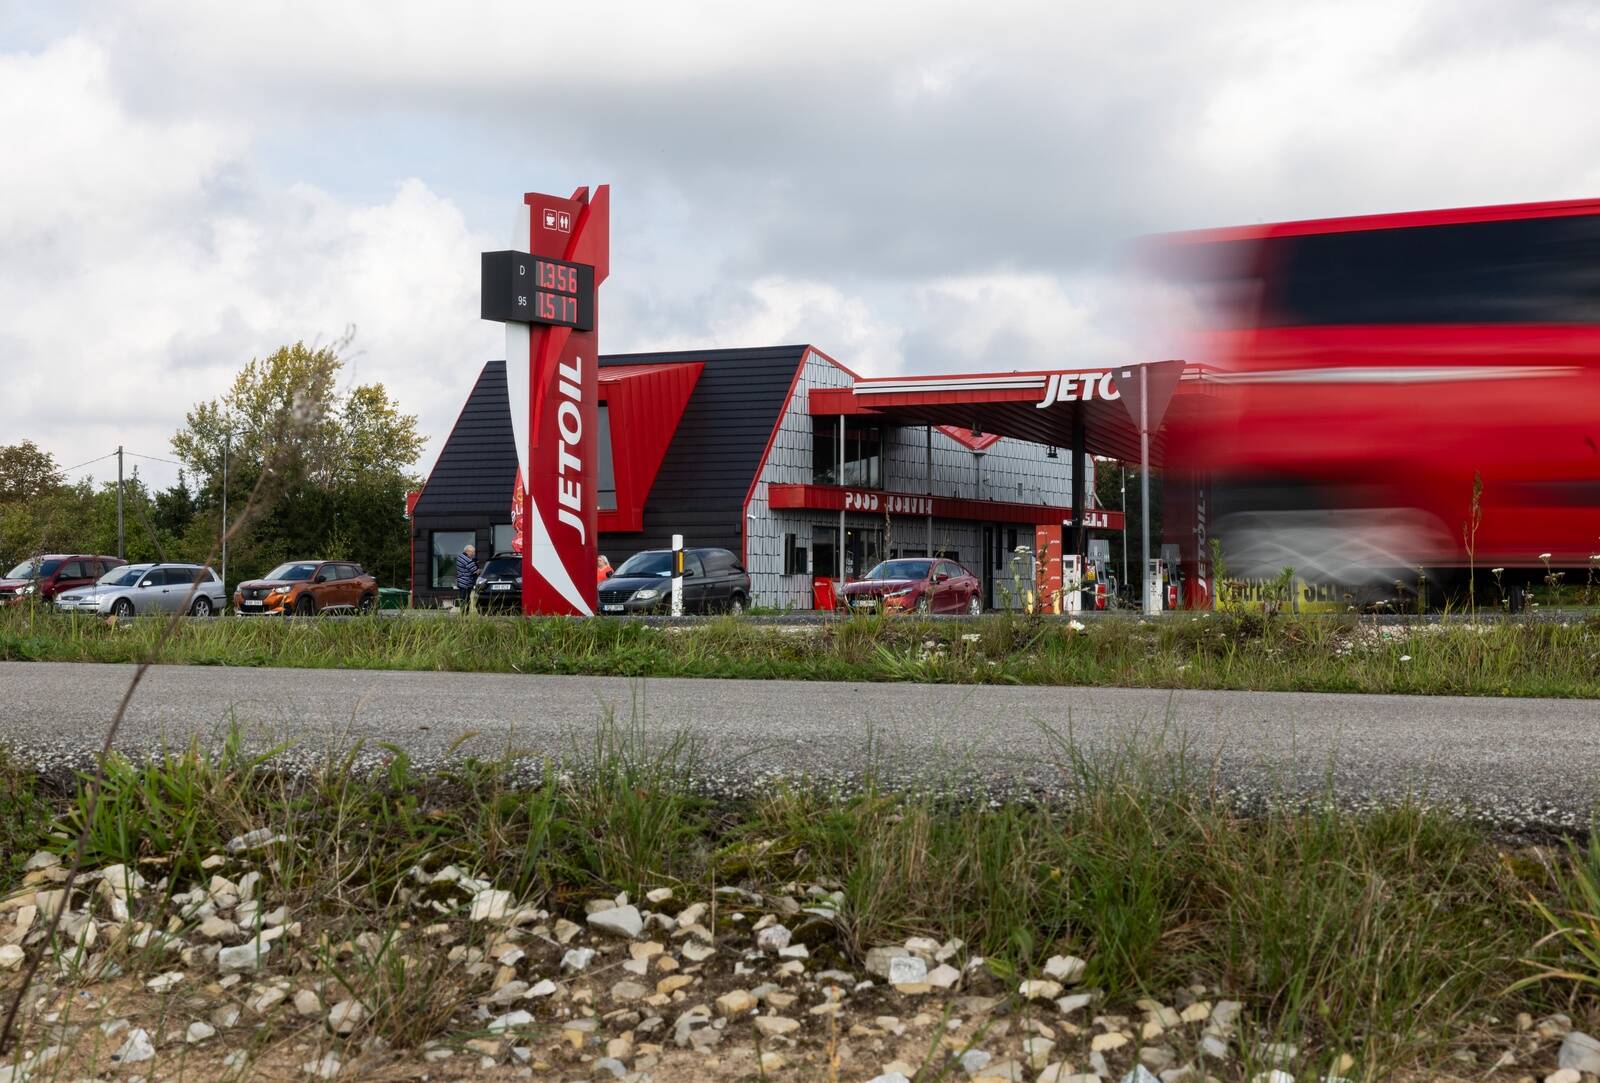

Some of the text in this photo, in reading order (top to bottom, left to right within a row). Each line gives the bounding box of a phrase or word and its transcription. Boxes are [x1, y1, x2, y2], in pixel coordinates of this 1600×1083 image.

[519, 265, 526, 276] D
[517, 295, 527, 307] 95
[1036, 372, 1121, 409] JETO
[558, 356, 586, 546] JETOIL
[844, 492, 879, 511] POOD
